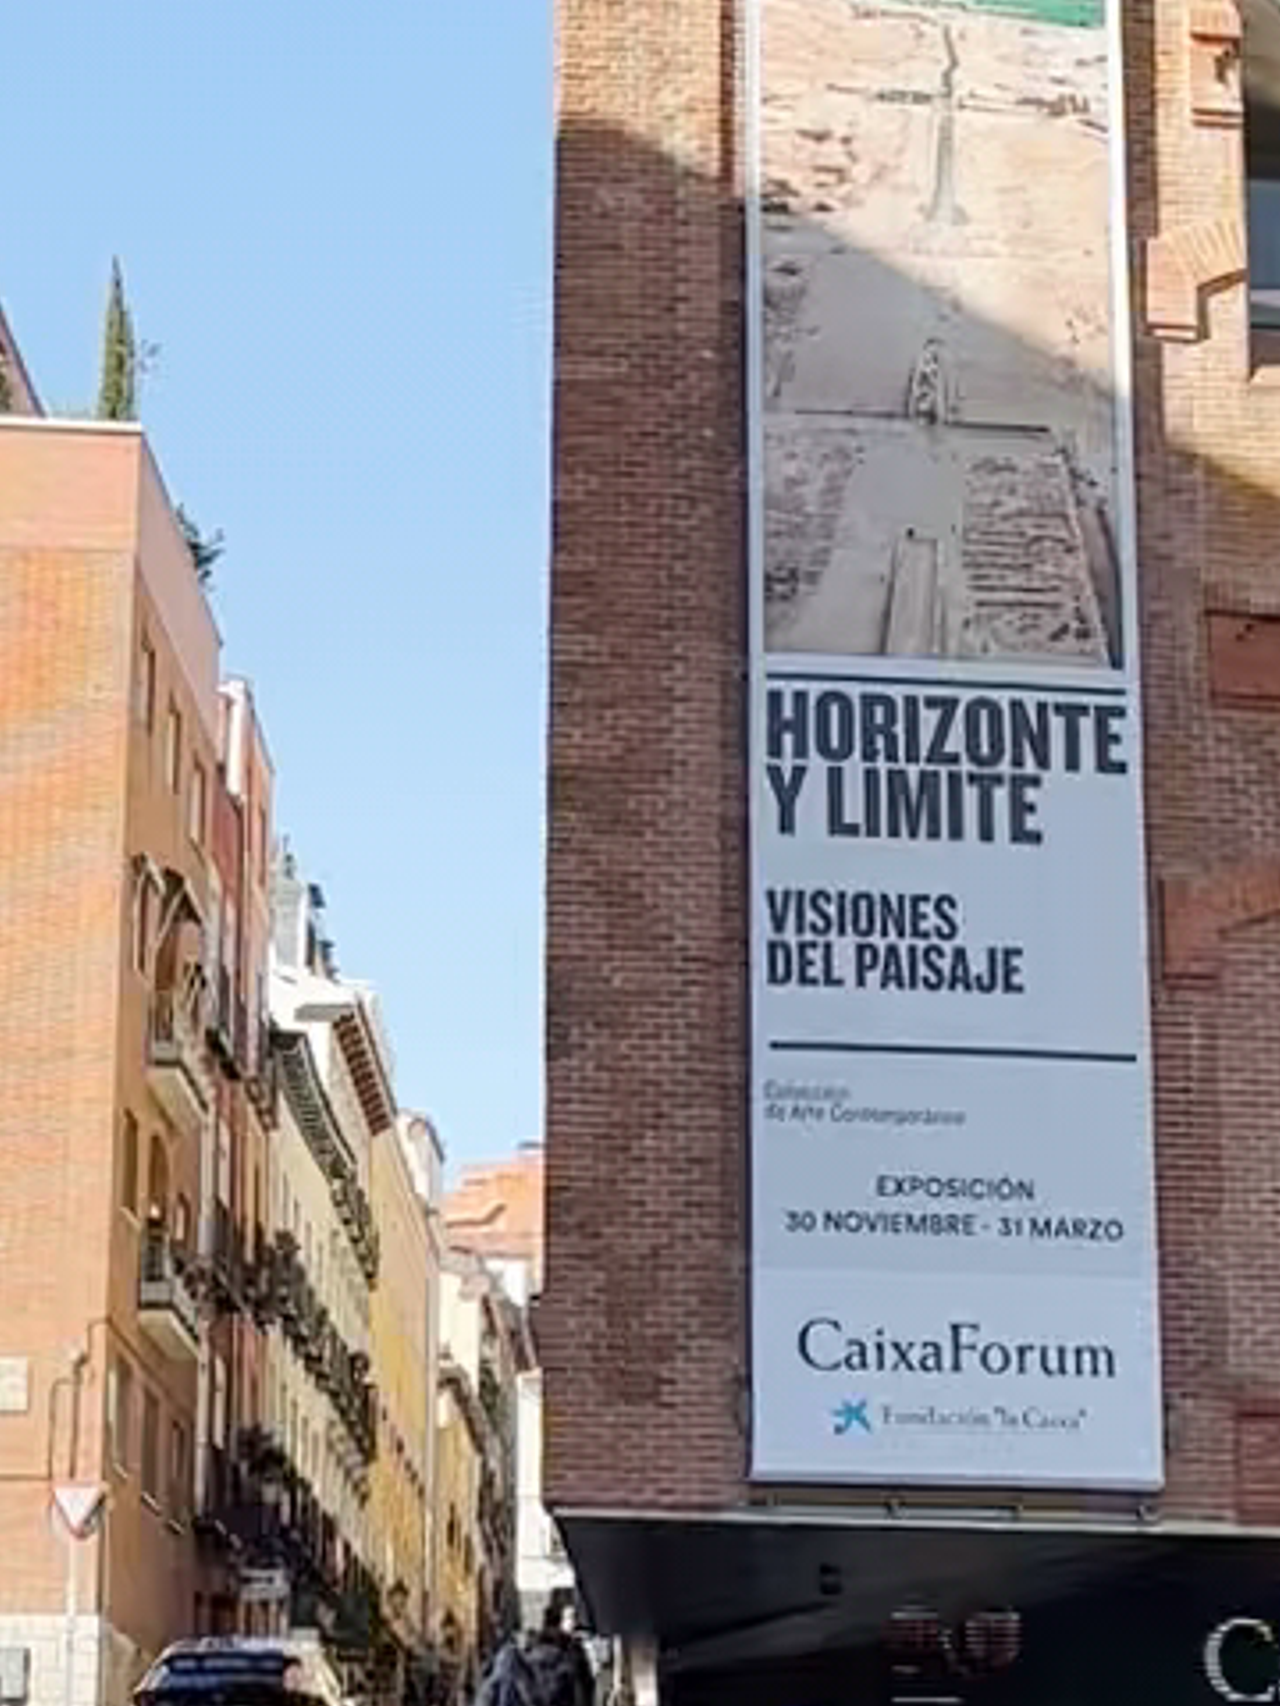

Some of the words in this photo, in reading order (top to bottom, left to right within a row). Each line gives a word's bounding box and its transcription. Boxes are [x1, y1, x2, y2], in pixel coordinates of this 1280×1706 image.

[766, 689, 1128, 774] HORIZONTE
[767, 765, 808, 835] Y
[766, 890, 958, 940] VISIONES
[767, 939, 845, 986] DEL
[855, 943, 1024, 994] PAISAJE
[875, 1174, 1035, 1201] EXPOSICIÓN
[784, 1210, 818, 1233] 30
[823, 1210, 977, 1237] NOVIEMBRE
[997, 1216, 1021, 1238] 31
[1028, 1217, 1125, 1242] MARZO
[796, 1317, 1117, 1379] CaixaForum
